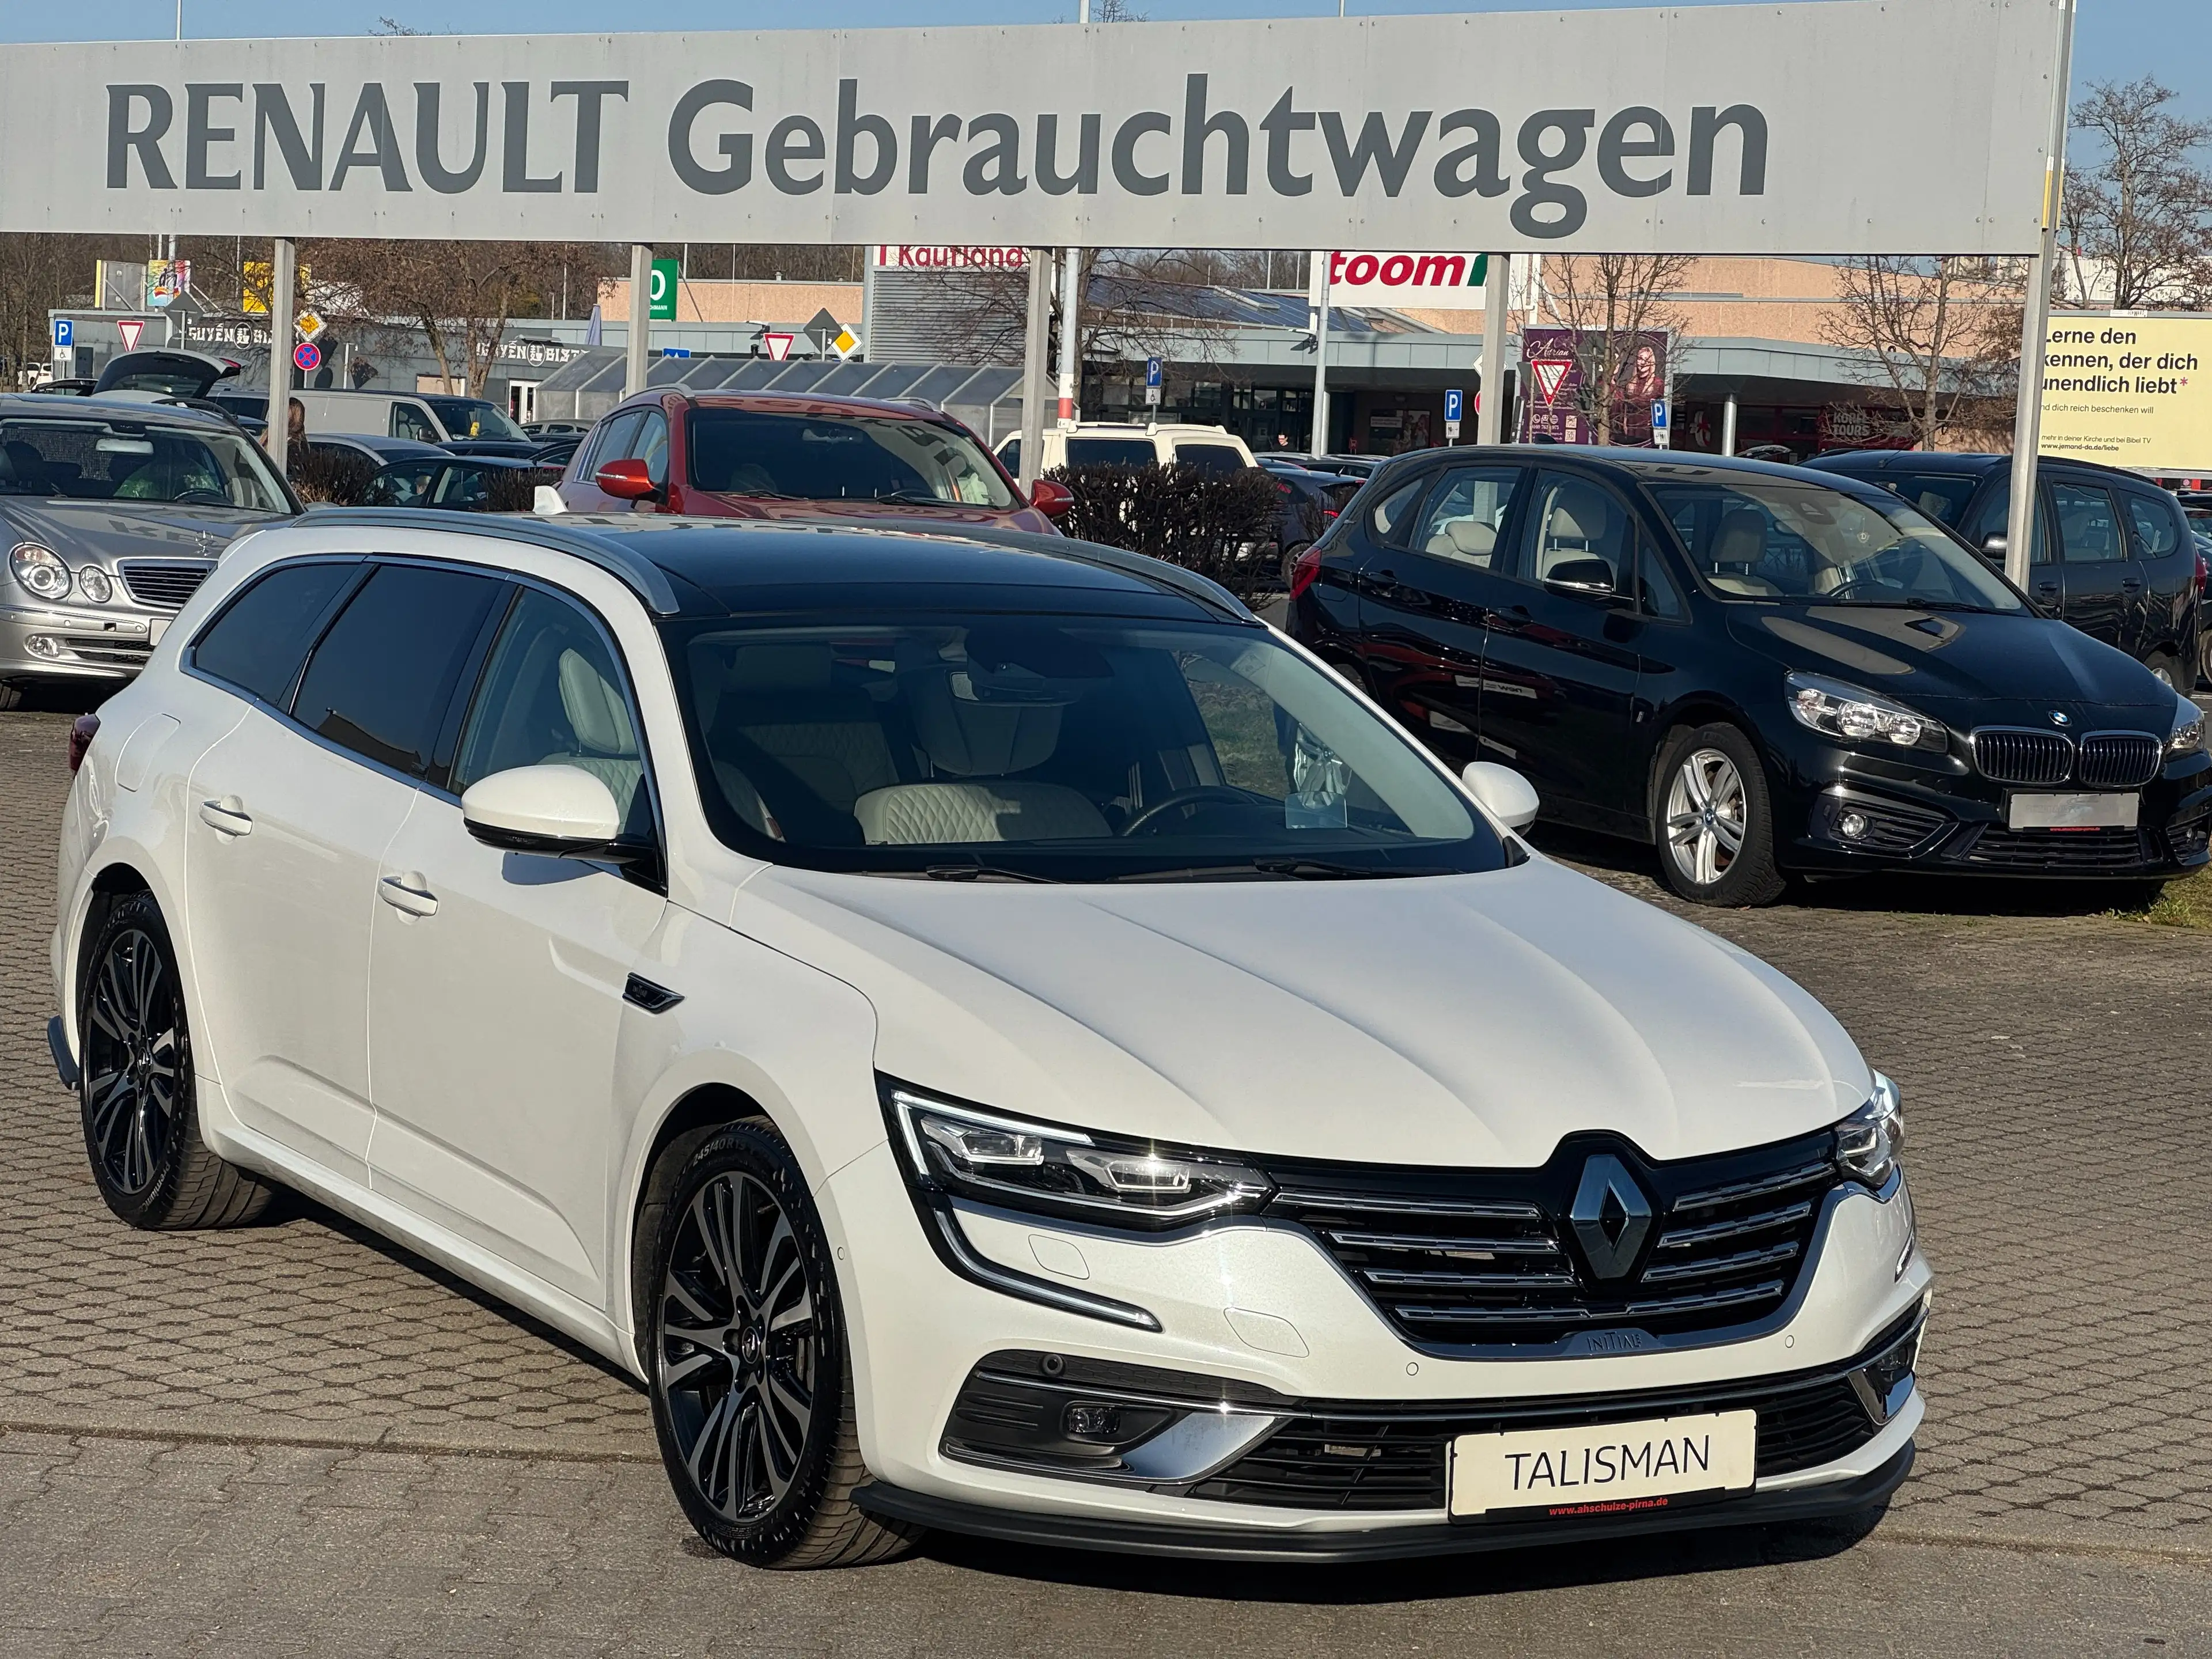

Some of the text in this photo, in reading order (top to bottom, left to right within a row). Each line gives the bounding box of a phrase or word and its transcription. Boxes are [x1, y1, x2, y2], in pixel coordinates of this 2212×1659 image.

[106, 73, 1768, 238] RENAULT Gebrauchtwagen
[1330, 251, 1465, 286] toom
[58, 323, 69, 343] P
[2100, 328, 2137, 344] den
[2119, 352, 2152, 369] der
[2157, 353, 2198, 370] dich
[1150, 361, 1159, 383] P
[1449, 394, 1459, 417] P
[1655, 406, 1663, 424] P
[2041, 403, 2154, 414] nd dich reich beschenken will
[1505, 1434, 1709, 1490] TALISMAN
[1550, 1498, 1668, 1516] www.ahschulze-pirna.de
